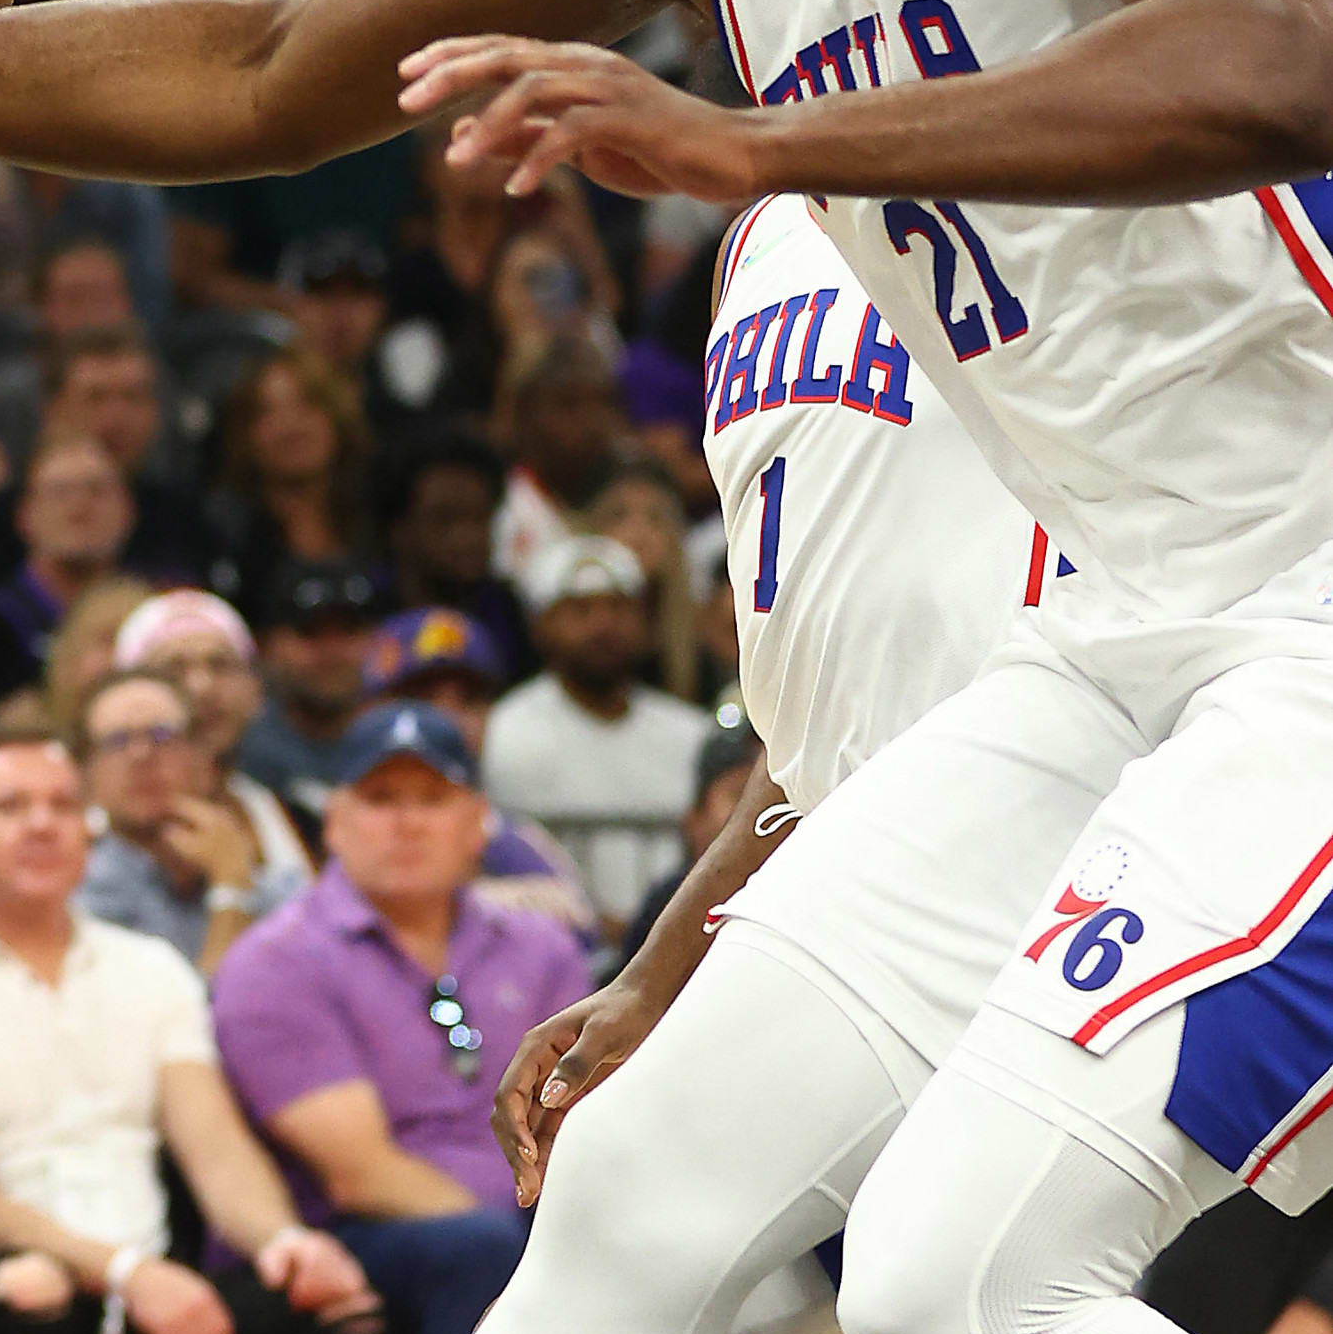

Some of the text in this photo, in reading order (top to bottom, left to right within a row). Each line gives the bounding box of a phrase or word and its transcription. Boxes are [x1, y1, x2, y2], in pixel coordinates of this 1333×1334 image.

[881, 200, 1030, 363] 21
[705, 288, 914, 435] PHILA
[753, 455, 786, 614] 1
[1023, 882, 1145, 993] 76
